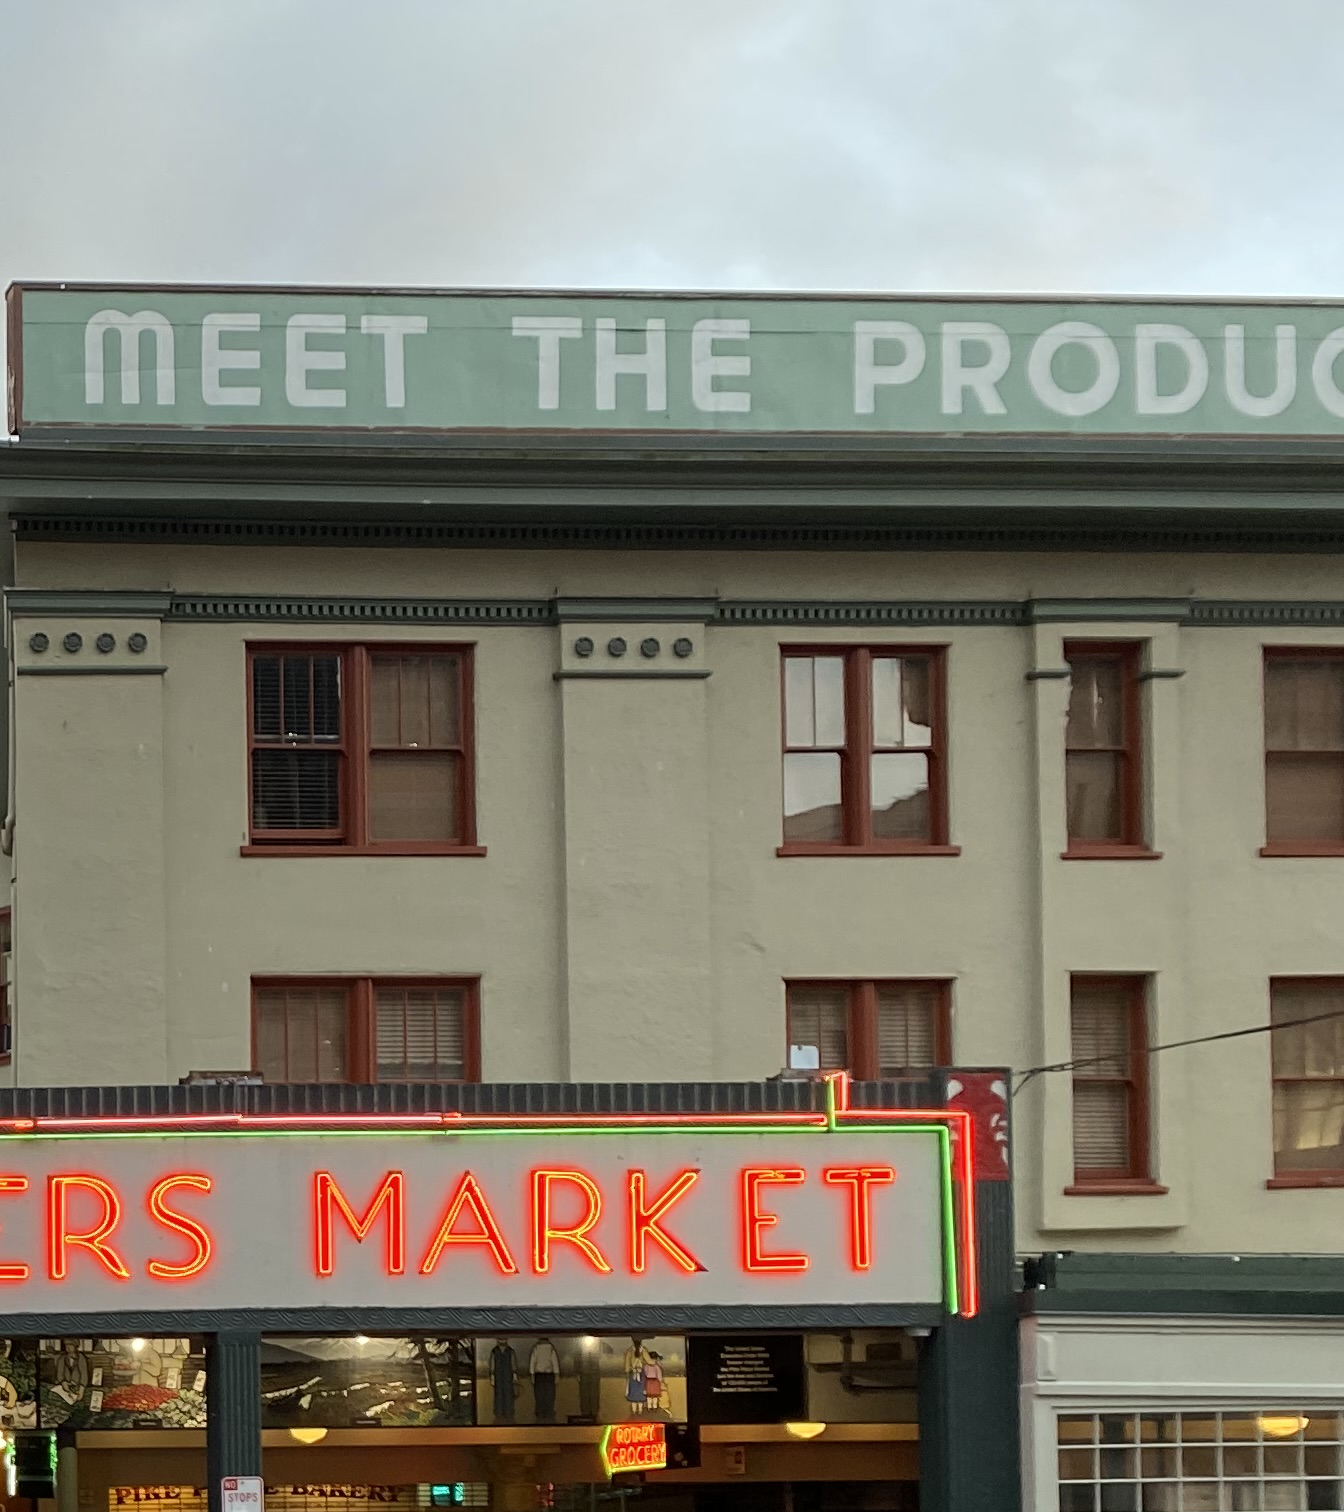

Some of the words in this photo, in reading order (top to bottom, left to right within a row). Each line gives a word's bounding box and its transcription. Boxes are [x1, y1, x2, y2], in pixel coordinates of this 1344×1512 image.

[84, 309, 428, 408] MEET
[511, 316, 753, 411] THE
[311, 1164, 896, 1279] MARKET
[615, 1425, 655, 1445] ROTARY
[611, 1442, 666, 1468] GROCERY
[224, 1480, 236, 1489] NO
[228, 1492, 258, 1502] STOPS
